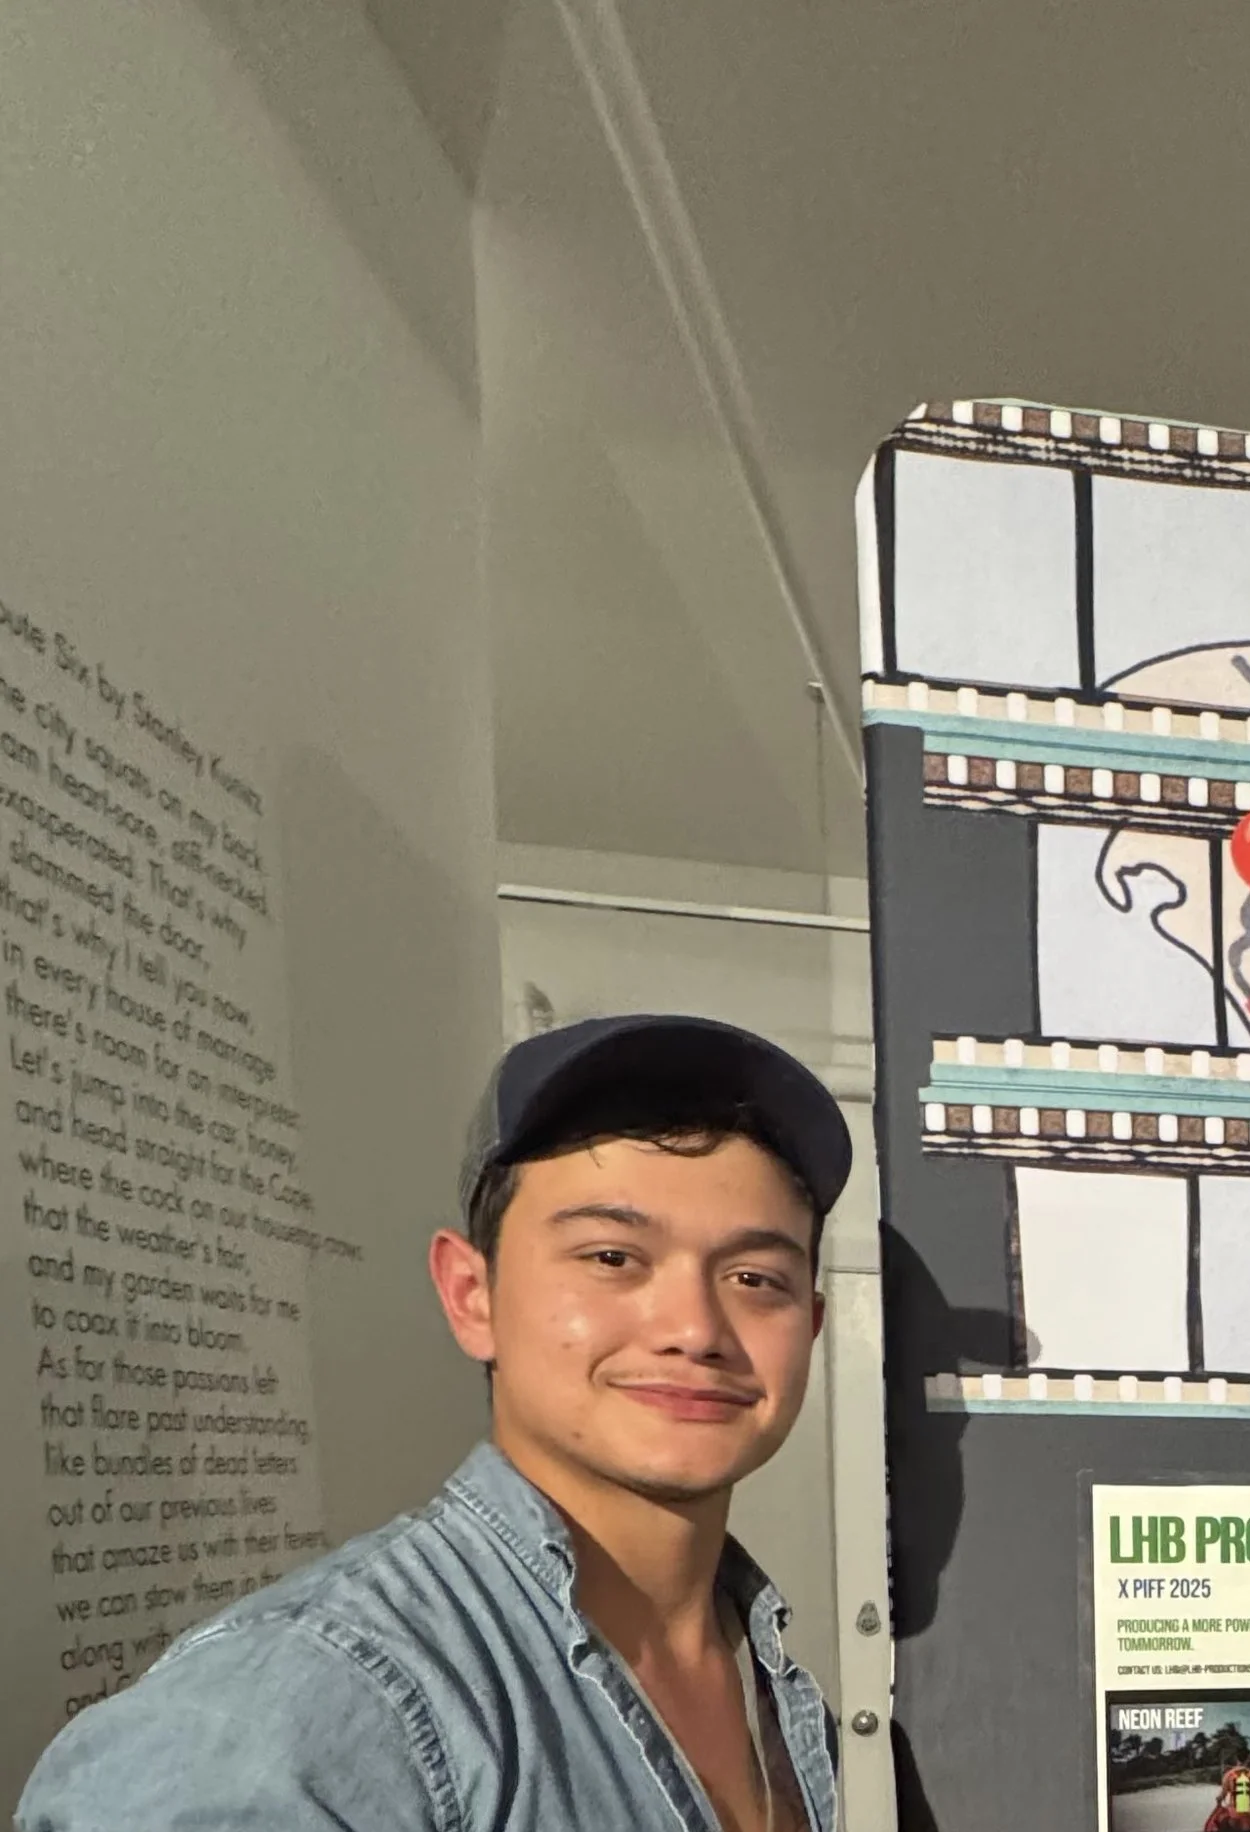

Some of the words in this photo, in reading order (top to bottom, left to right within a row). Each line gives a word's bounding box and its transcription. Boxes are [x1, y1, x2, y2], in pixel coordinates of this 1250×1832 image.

[97, 662, 125, 720] by
[1, 732, 39, 775] am
[158, 788, 182, 822] on
[10, 830, 114, 916] slammed
[122, 890, 154, 936] the
[210, 902, 247, 952] why
[71, 920, 118, 972] why
[173, 973, 207, 1007] you
[2, 928, 25, 971] in
[34, 955, 98, 1013] every
[105, 970, 167, 1032] house
[172, 1010, 191, 1041] of
[198, 1030, 276, 1086] marriage
[6, 978, 86, 1046] there's
[93, 1029, 148, 1070] room
[154, 1041, 180, 1081] for
[187, 1069, 211, 1097] an
[70, 1058, 126, 1115] jump
[131, 1081, 169, 1122] into
[174, 1100, 204, 1135] the
[16, 1096, 62, 1133] and
[70, 1098, 126, 1153] head
[135, 1136, 206, 1182] straight
[210, 1150, 235, 1185] for
[239, 1162, 264, 1195] the
[18, 1143, 93, 1190] where
[100, 1158, 133, 1200] the
[138, 1180, 184, 1213] cock
[190, 1199, 213, 1220] on
[219, 1206, 247, 1229] our
[23, 1188, 69, 1233] that
[76, 1202, 110, 1242] the
[29, 1247, 74, 1283] and
[83, 1264, 115, 1298] my
[121, 1266, 193, 1303] garden
[200, 1285, 246, 1313] waits
[250, 1283, 273, 1315] for
[276, 1300, 301, 1322] me
[32, 1298, 56, 1329] to
[64, 1309, 119, 1337] coax
[126, 1310, 139, 1341] it
[145, 1312, 181, 1345] into
[37, 1345, 68, 1379] As
[75, 1344, 104, 1380] for
[113, 1352, 166, 1386] those
[172, 1369, 250, 1397] passions
[253, 1363, 279, 1394] left
[41, 1391, 83, 1427] that
[91, 1393, 140, 1431] flare
[147, 1409, 187, 1439] past
[44, 1441, 85, 1476] like
[93, 1441, 172, 1476] bundles
[180, 1442, 198, 1475] of
[203, 1443, 249, 1475] dead
[252, 1446, 297, 1475] letters
[48, 1498, 83, 1527] out
[91, 1488, 113, 1523] of
[120, 1501, 152, 1522] our
[160, 1498, 237, 1530] previous
[240, 1487, 277, 1515] lives
[52, 1541, 94, 1574] that
[102, 1545, 172, 1571] amaze
[178, 1542, 198, 1562] us
[203, 1530, 238, 1557] with
[244, 1527, 279, 1552] their
[1110, 1516, 1186, 1563] LHB
[56, 1599, 90, 1622] we
[98, 1593, 137, 1617] can
[145, 1583, 187, 1611] stow
[193, 1572, 235, 1602] them
[1118, 1578, 1129, 1598] X
[1133, 1578, 1165, 1598] PIFF
[1170, 1578, 1211, 1598] 2025
[1117, 1619, 1179, 1633] PRODUCING
[1182, 1619, 1189, 1632] A
[1192, 1618, 1222, 1632] MORE
[1117, 1637, 1194, 1651] TOMMORROW.
[61, 1632, 123, 1671] along
[1118, 1665, 1149, 1675] CONTACT
[1118, 1709, 1161, 1730] NEON
[1165, 1708, 1204, 1728] REEF
